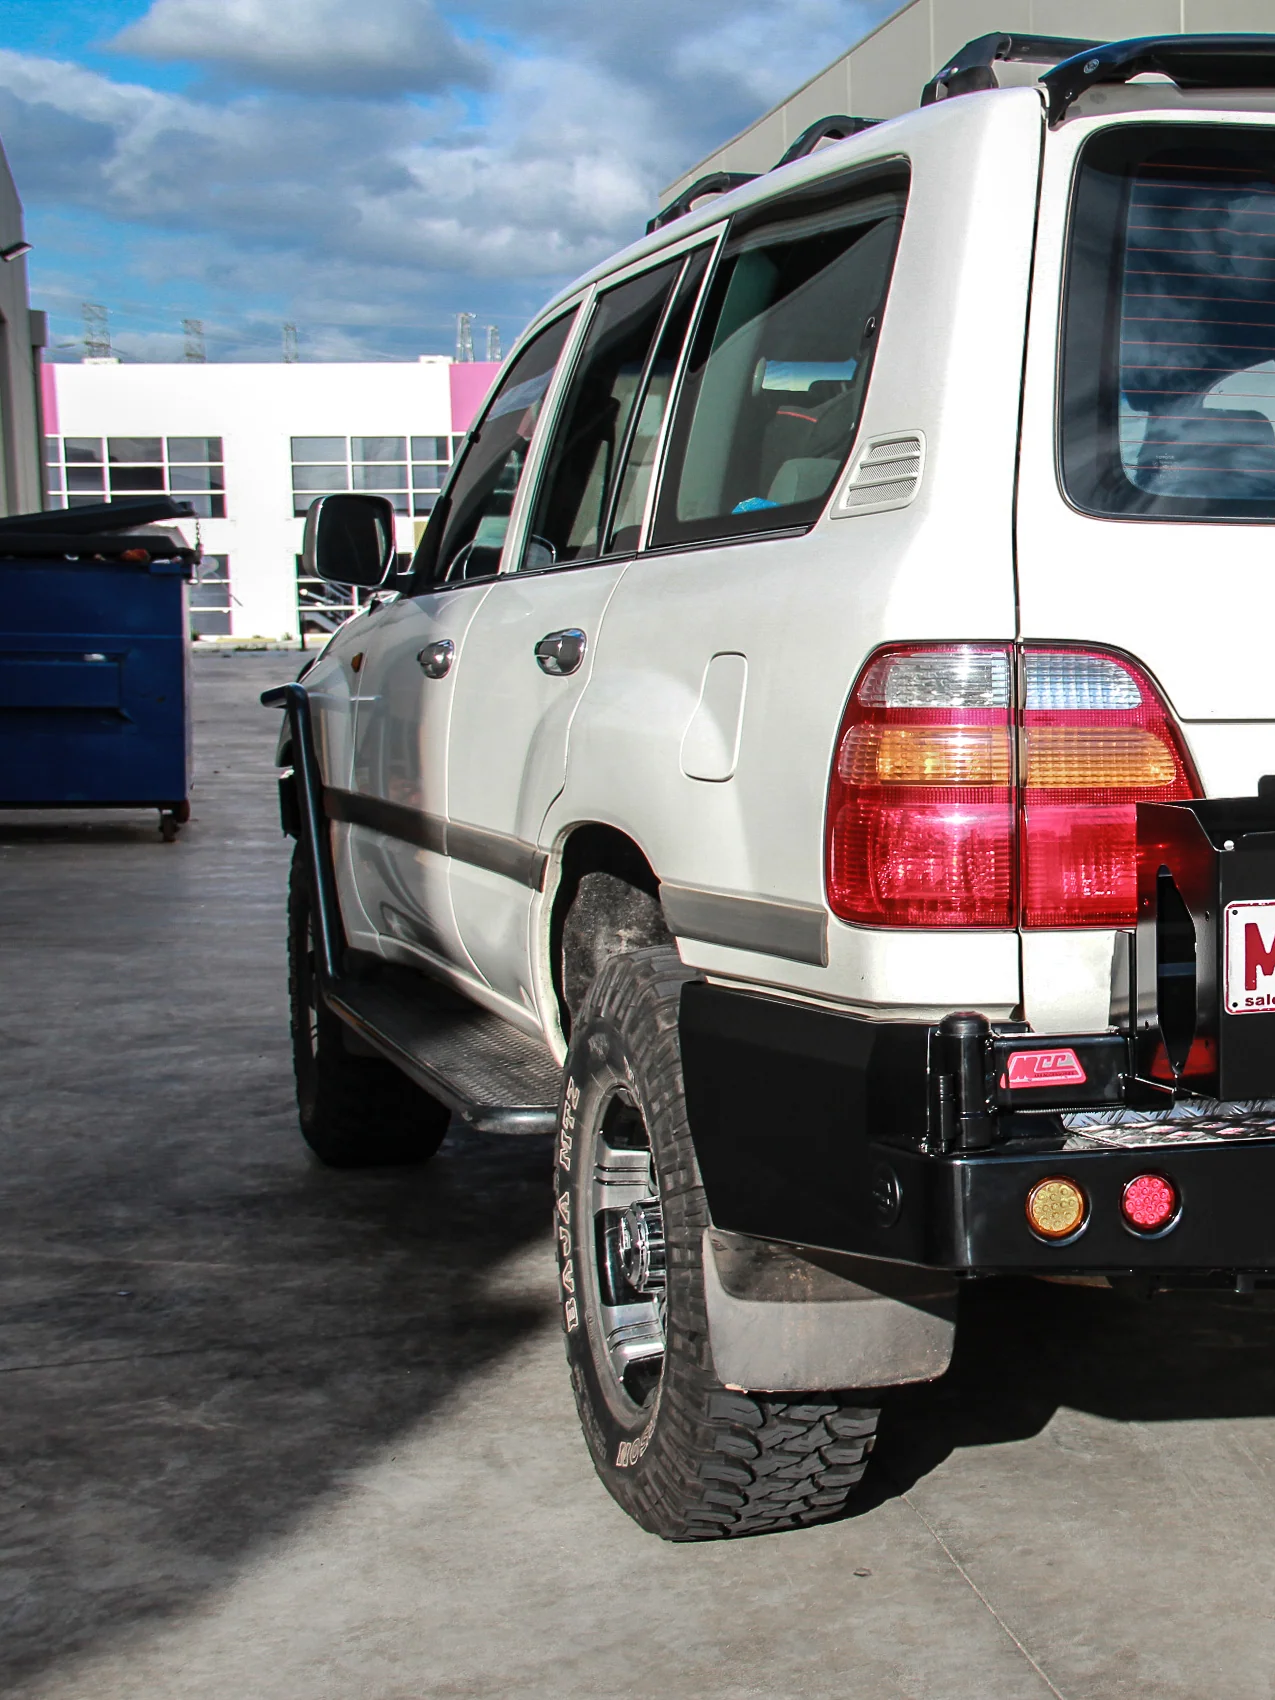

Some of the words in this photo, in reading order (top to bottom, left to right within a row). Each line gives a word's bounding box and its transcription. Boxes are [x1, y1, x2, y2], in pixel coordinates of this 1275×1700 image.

[1008, 1054, 1077, 1081] MCC
[559, 1075, 581, 1172] MTZ
[558, 1191, 579, 1333] BAJA
